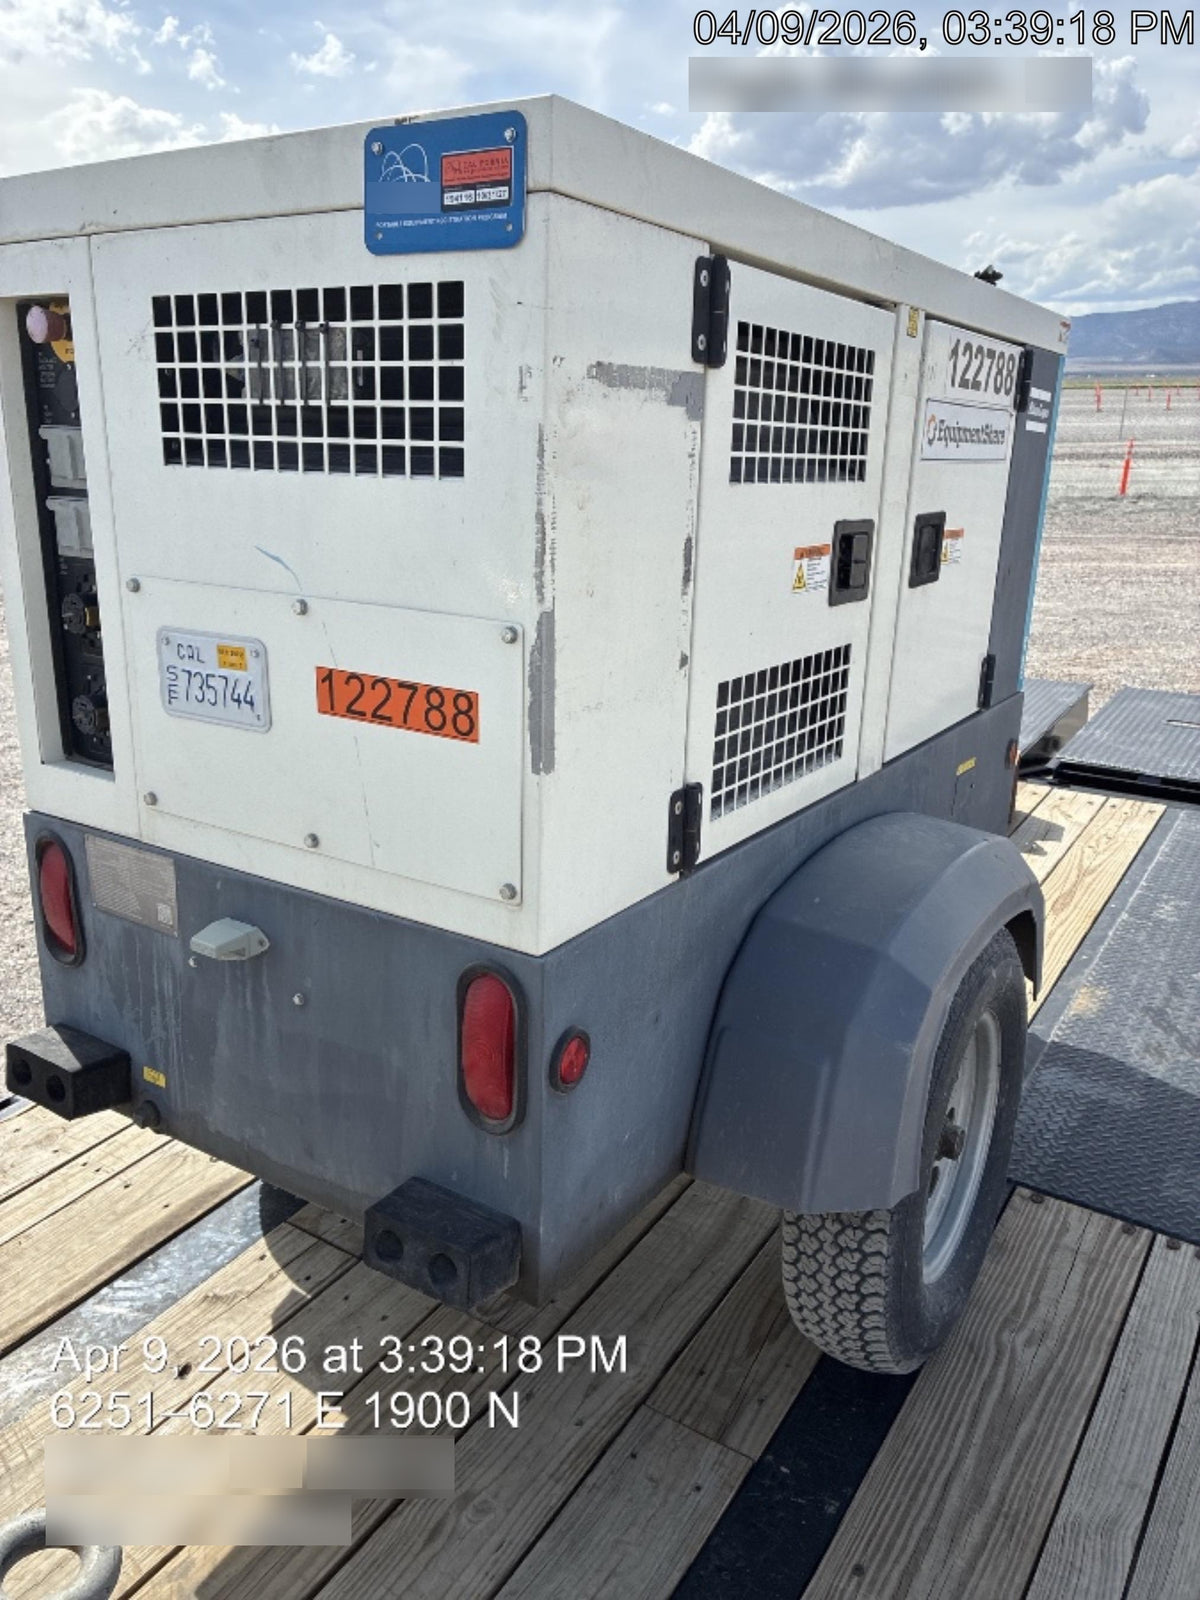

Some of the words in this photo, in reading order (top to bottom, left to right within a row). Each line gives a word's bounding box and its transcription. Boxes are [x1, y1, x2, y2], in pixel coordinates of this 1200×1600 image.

[950, 338, 1016, 397] 122788
[177, 643, 206, 664] CAL
[181, 668, 255, 713] 735744
[320, 668, 476, 737] 122788
